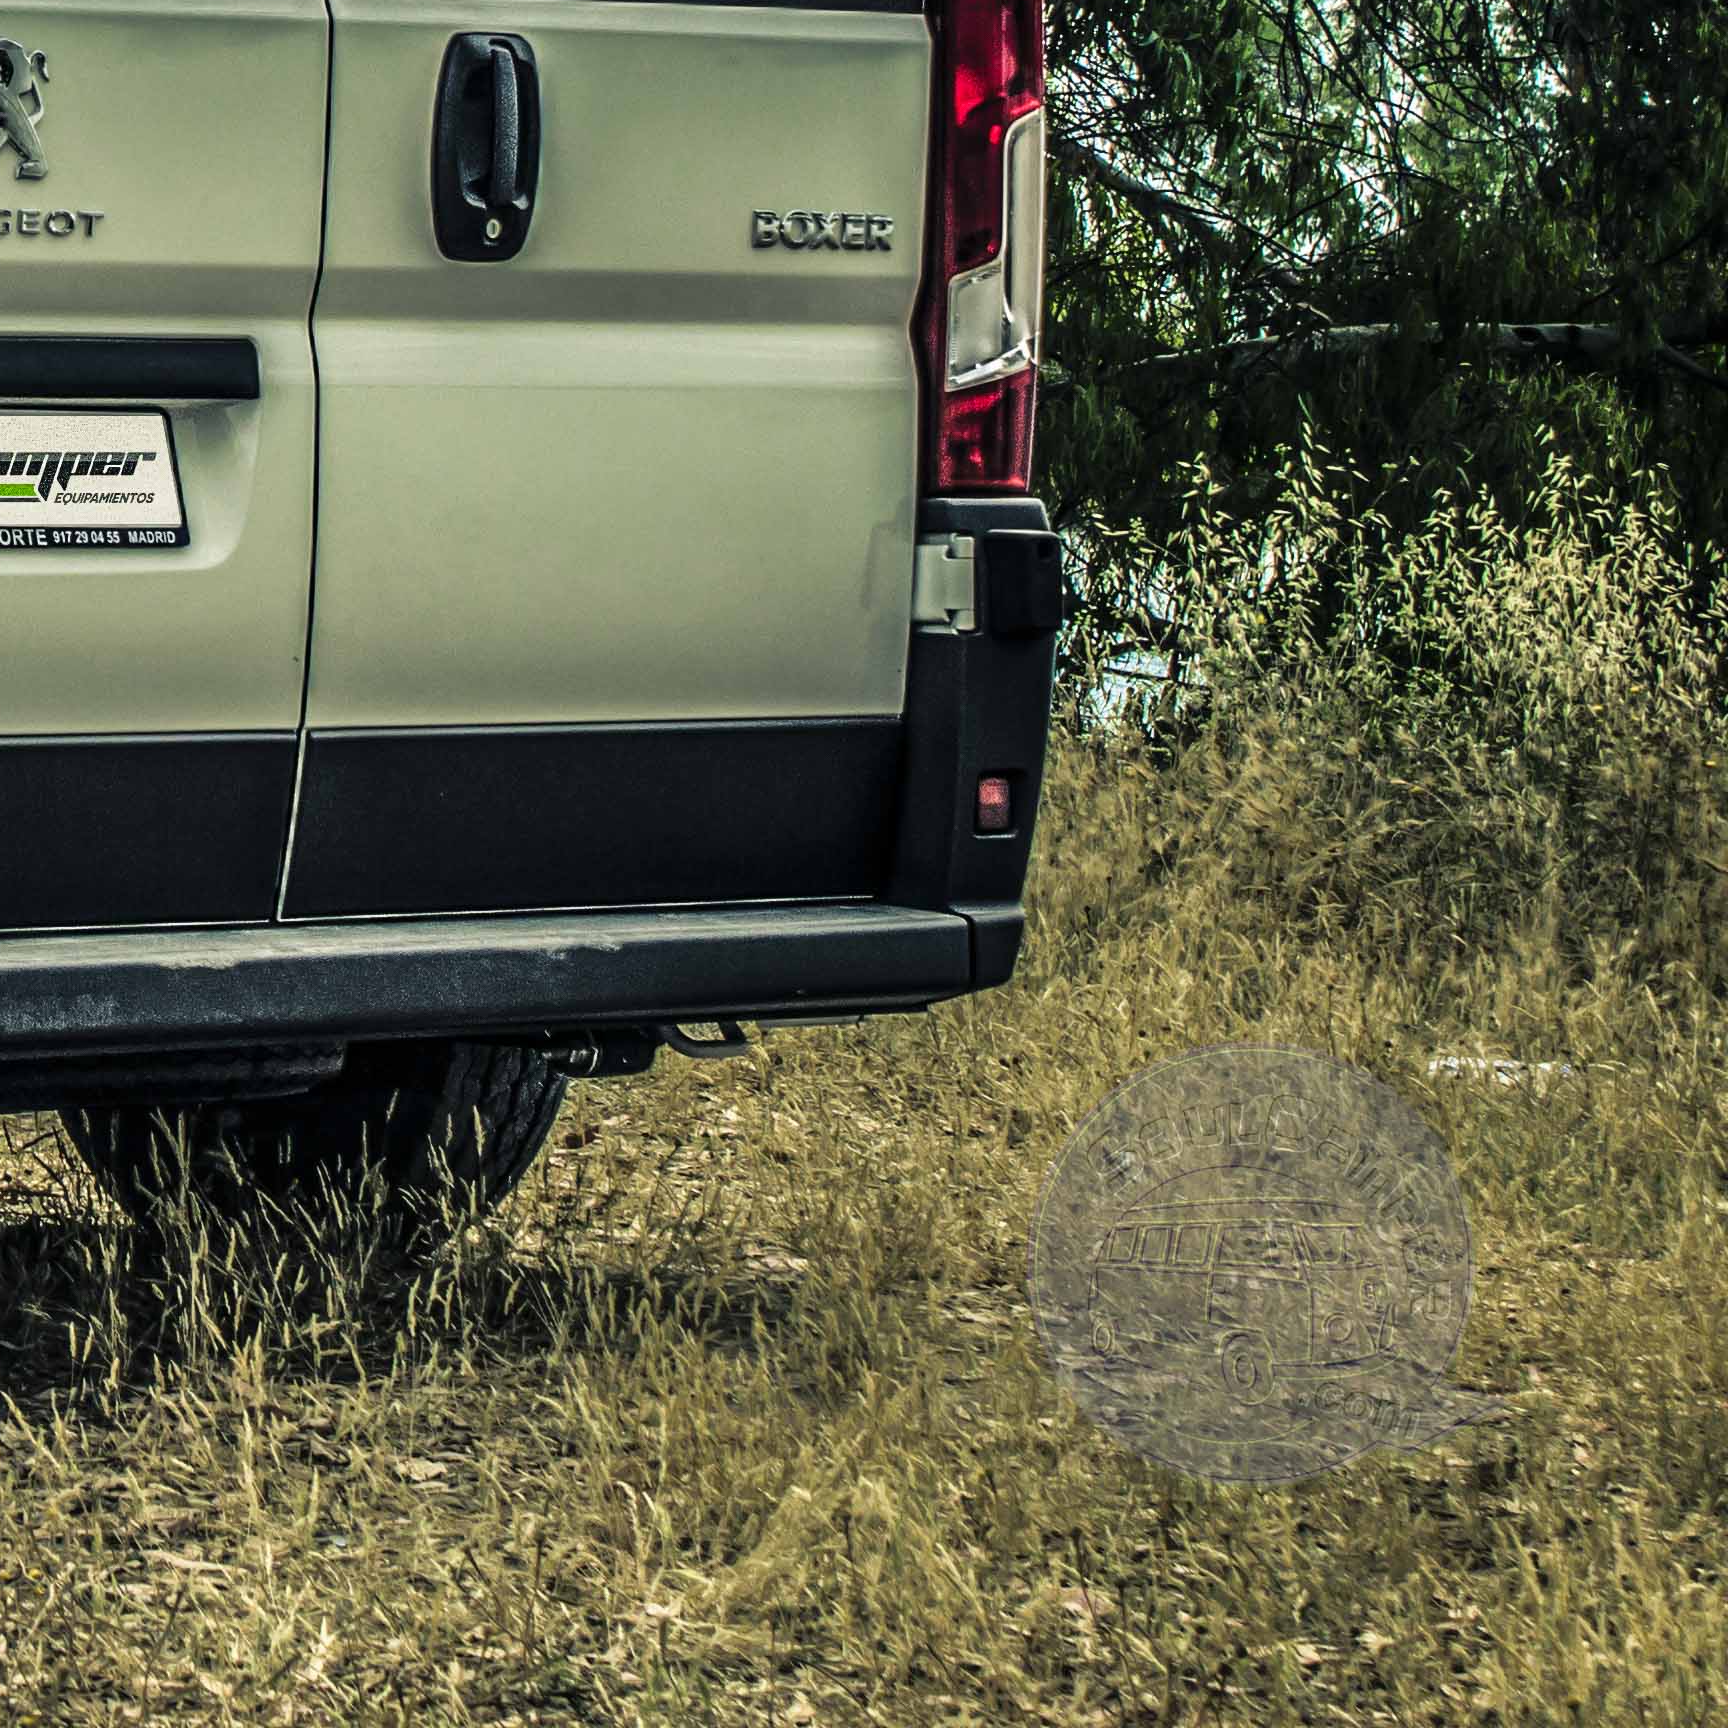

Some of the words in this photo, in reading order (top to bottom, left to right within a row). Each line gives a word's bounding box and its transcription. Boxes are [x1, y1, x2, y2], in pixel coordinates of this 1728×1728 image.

[751, 208, 894, 251] BOXER
[54, 492, 155, 506] EQUIPAMIENTOS
[52, 530, 72, 544] 917
[74, 530, 89, 544] 29
[90, 530, 105, 544] 04
[106, 530, 121, 544] 55
[127, 530, 176, 544] MADRID
